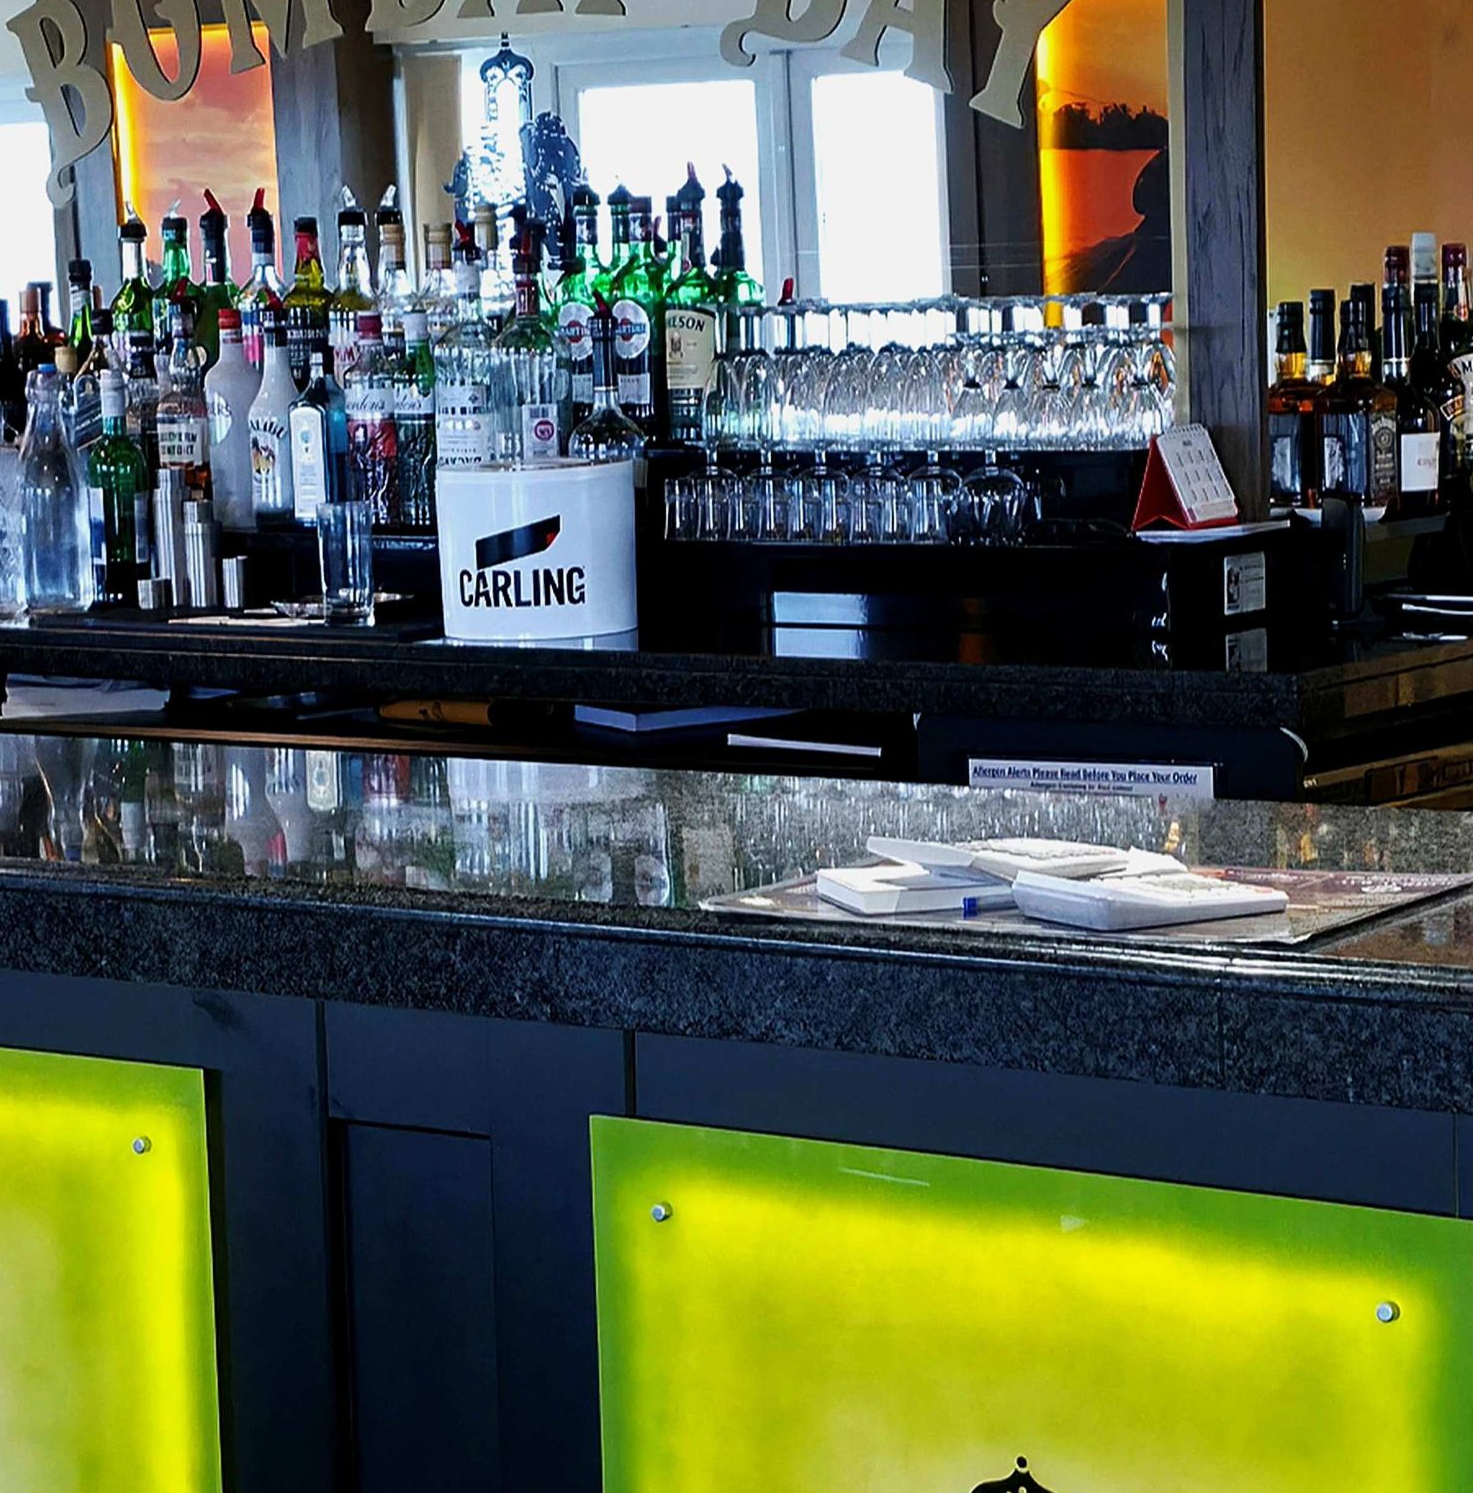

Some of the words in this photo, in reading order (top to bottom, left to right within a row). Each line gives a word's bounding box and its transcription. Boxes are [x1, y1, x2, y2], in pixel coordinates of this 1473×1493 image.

[459, 566, 586, 608] CARLING
[1032, 767, 1059, 780] Please
[1082, 769, 1109, 782] Before
[1110, 770, 1127, 782] You
[1172, 772, 1198, 785] Order
